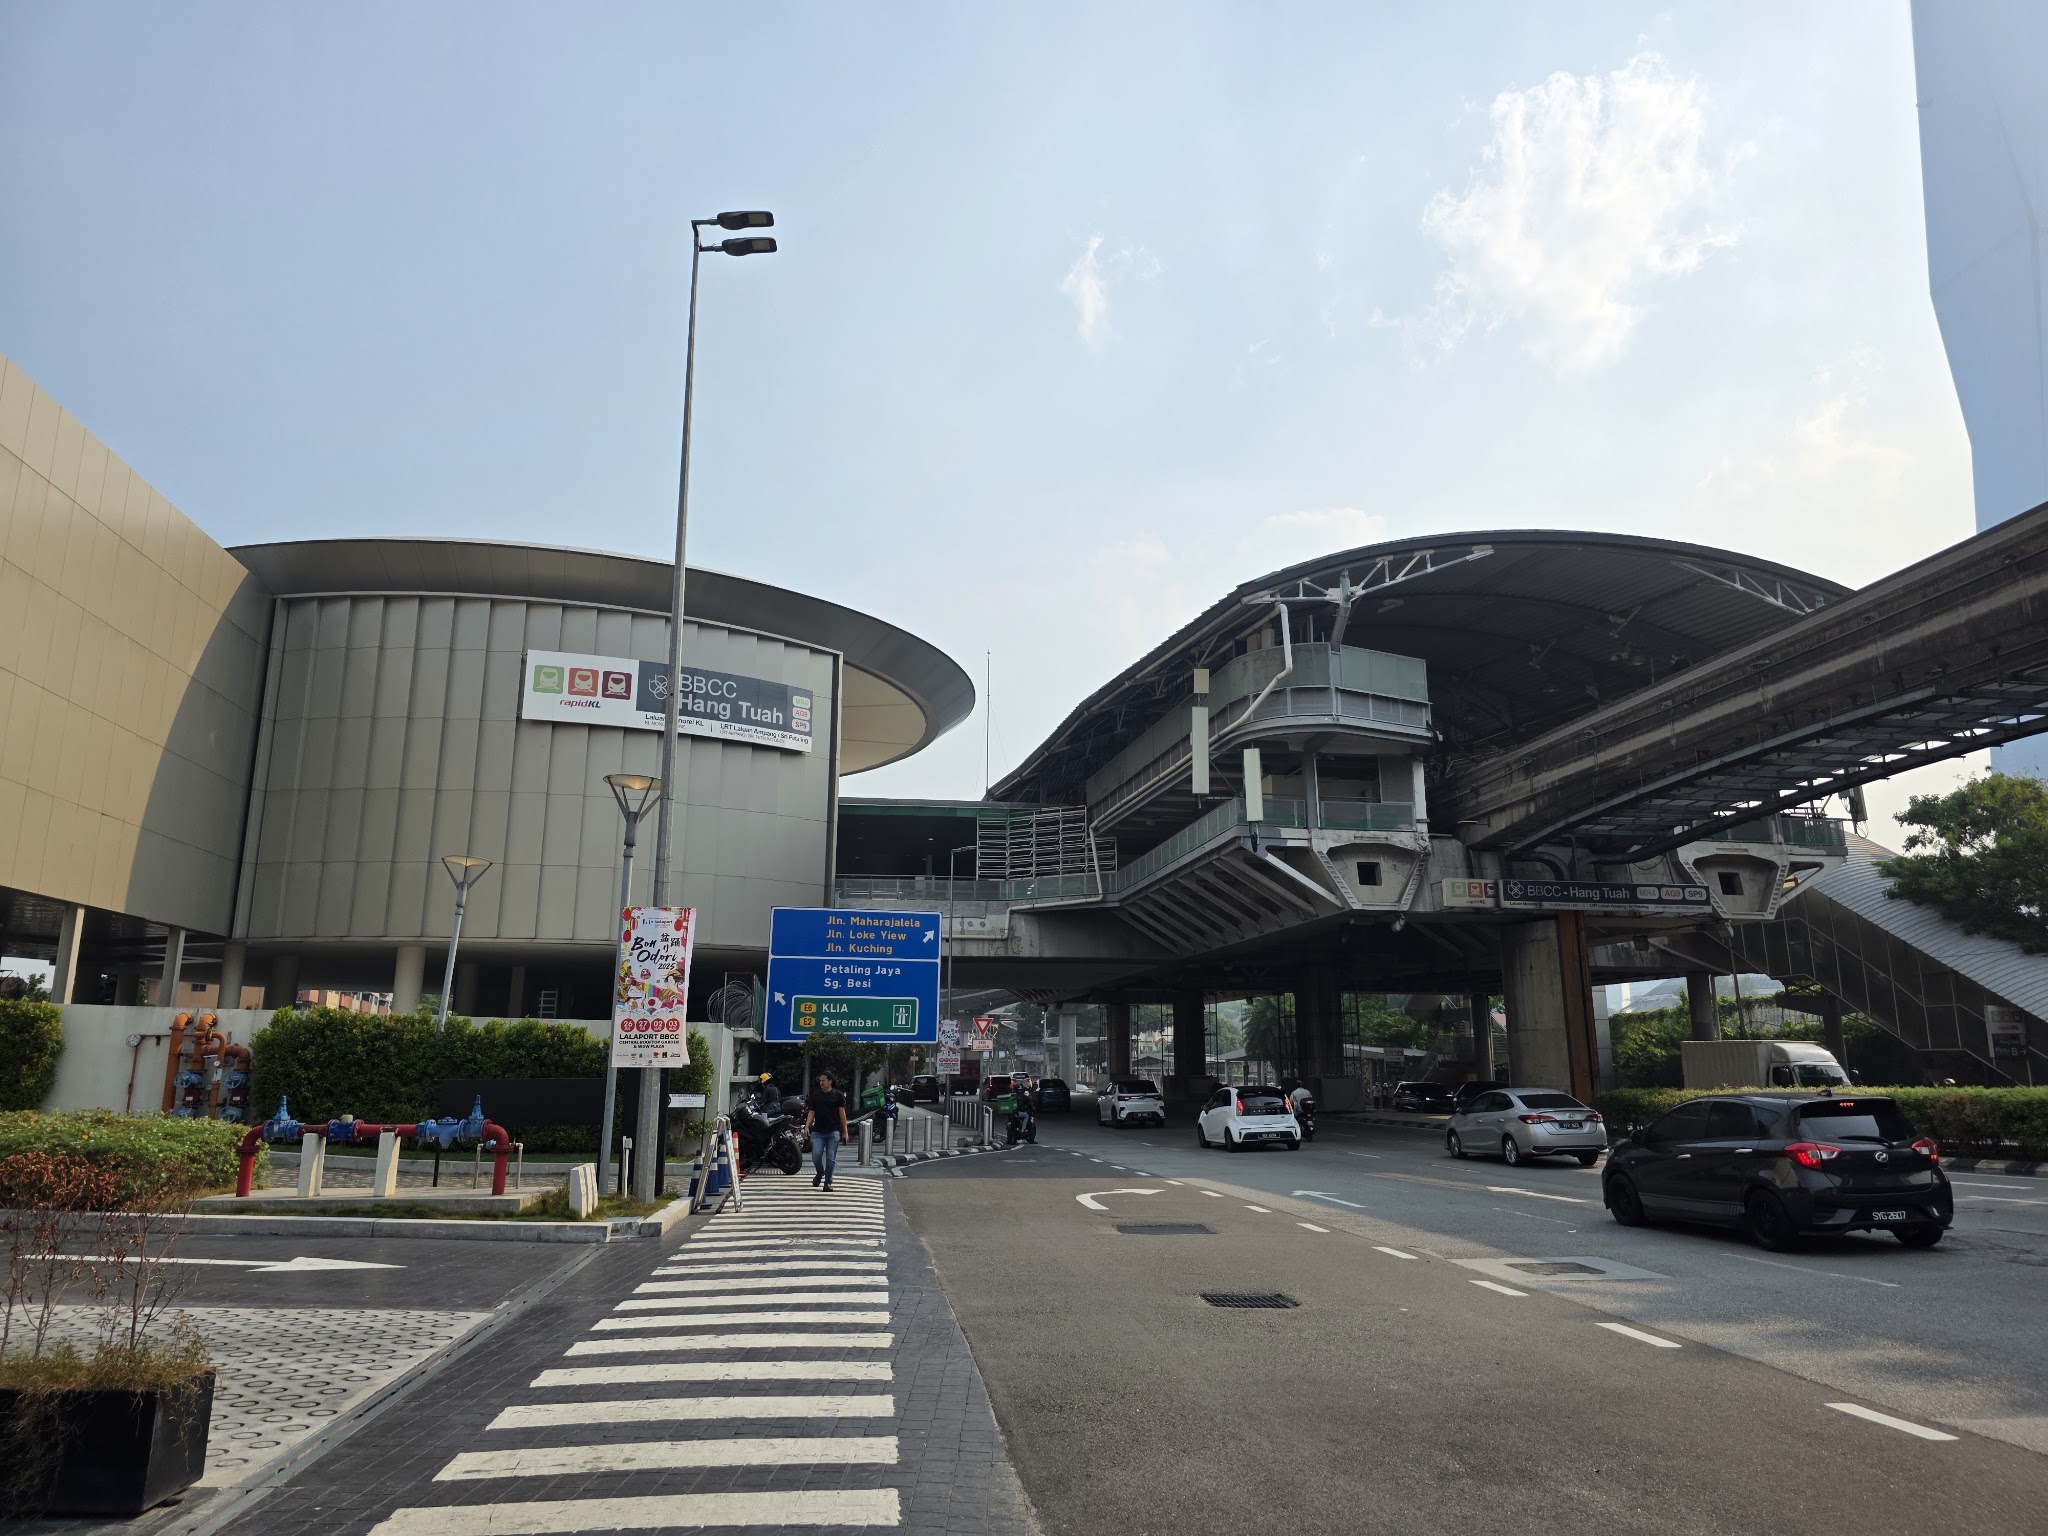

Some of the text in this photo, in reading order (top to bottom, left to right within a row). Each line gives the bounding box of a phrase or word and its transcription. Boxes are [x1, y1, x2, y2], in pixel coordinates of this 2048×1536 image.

[680, 674, 737, 698] BBCC
[560, 699, 601, 709] rapidKL
[680, 693, 783, 725] Hang Tuah
[795, 721, 807, 729] SP9
[1527, 885, 1561, 897] BBCC
[1570, 887, 1600, 900] Hang
[1602, 887, 1630, 899] Tuah
[1688, 890, 1703, 898] SP9
[827, 916, 920, 928] Jln. Maharajalela
[826, 930, 907, 940] Jln. Loke Yiew
[631, 936, 657, 951] Bon
[826, 943, 893, 954] Jln. Kuching
[637, 949, 677, 964] Odori
[824, 965, 901, 977] Petaling Jaya
[824, 978, 871, 989] Sg. Besi
[804, 1003, 849, 1013] E6 KLIA
[803, 1017, 879, 1027] E2 Seremban
[2012, 1048, 2018, 1056] B
